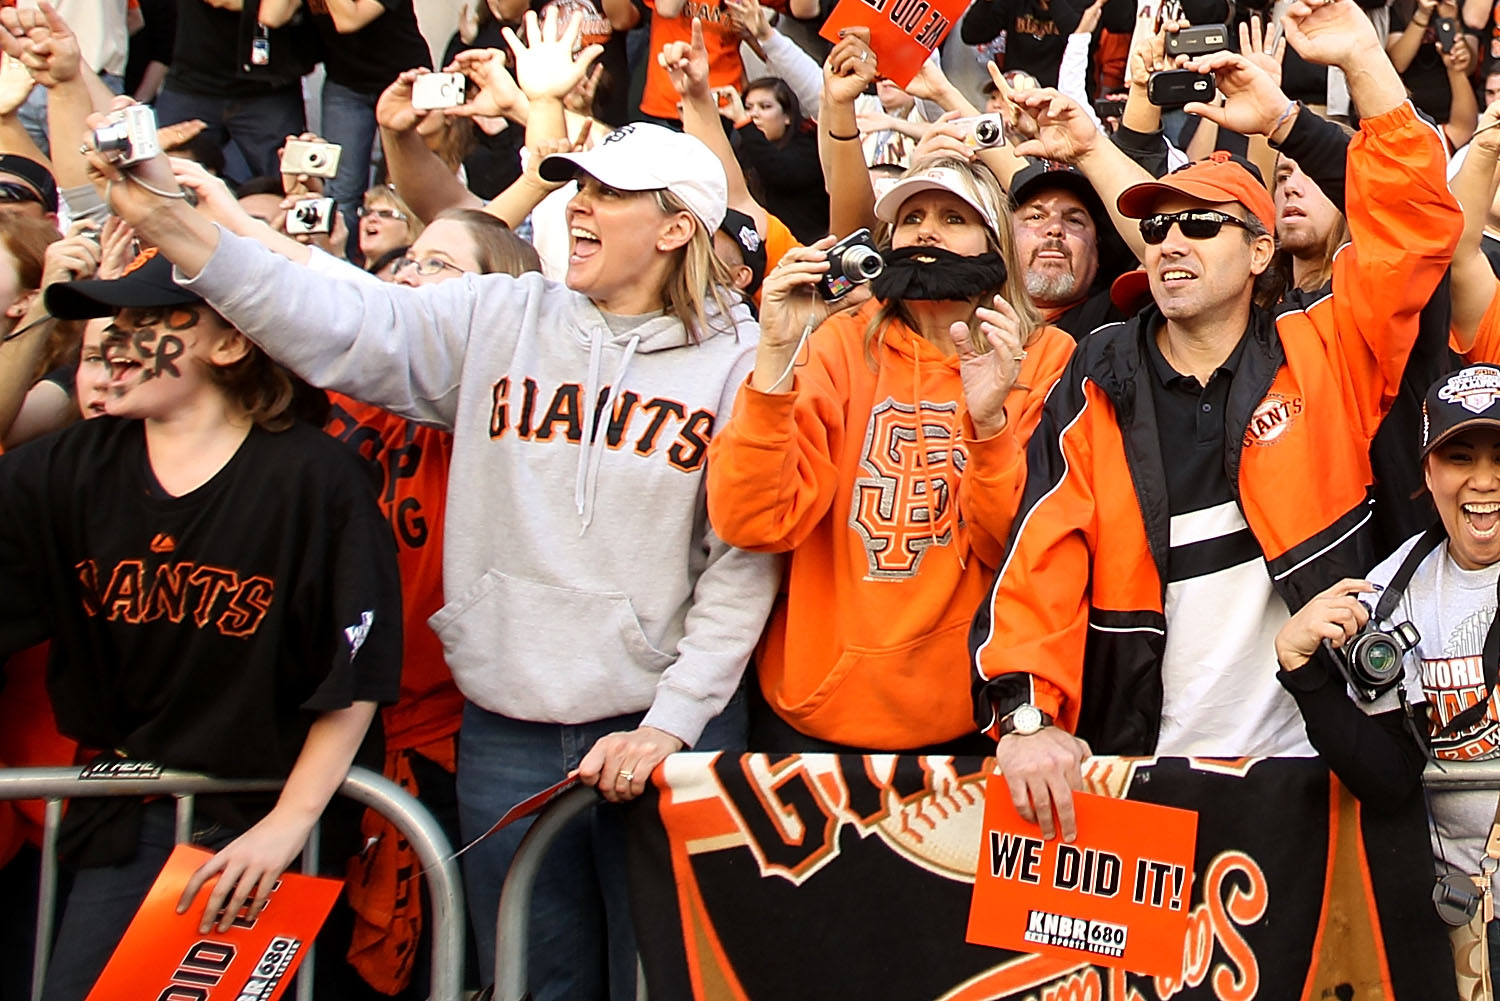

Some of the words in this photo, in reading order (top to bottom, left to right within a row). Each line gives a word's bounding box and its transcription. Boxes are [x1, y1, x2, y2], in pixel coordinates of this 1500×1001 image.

[914, 9, 950, 52] WE
[490, 375, 716, 473] GIANTS
[848, 396, 970, 578] SF
[1423, 655, 1486, 688] WORL
[989, 830, 1044, 885] WE
[1053, 843, 1123, 898] DID
[1132, 857, 1186, 911] IT!
[1029, 910, 1088, 941] KNBR
[1090, 923, 1125, 945] 680
[1051, 935, 1086, 951] SPORTS
[1088, 942, 1123, 958] LEADER
[257, 938, 292, 978] 680
